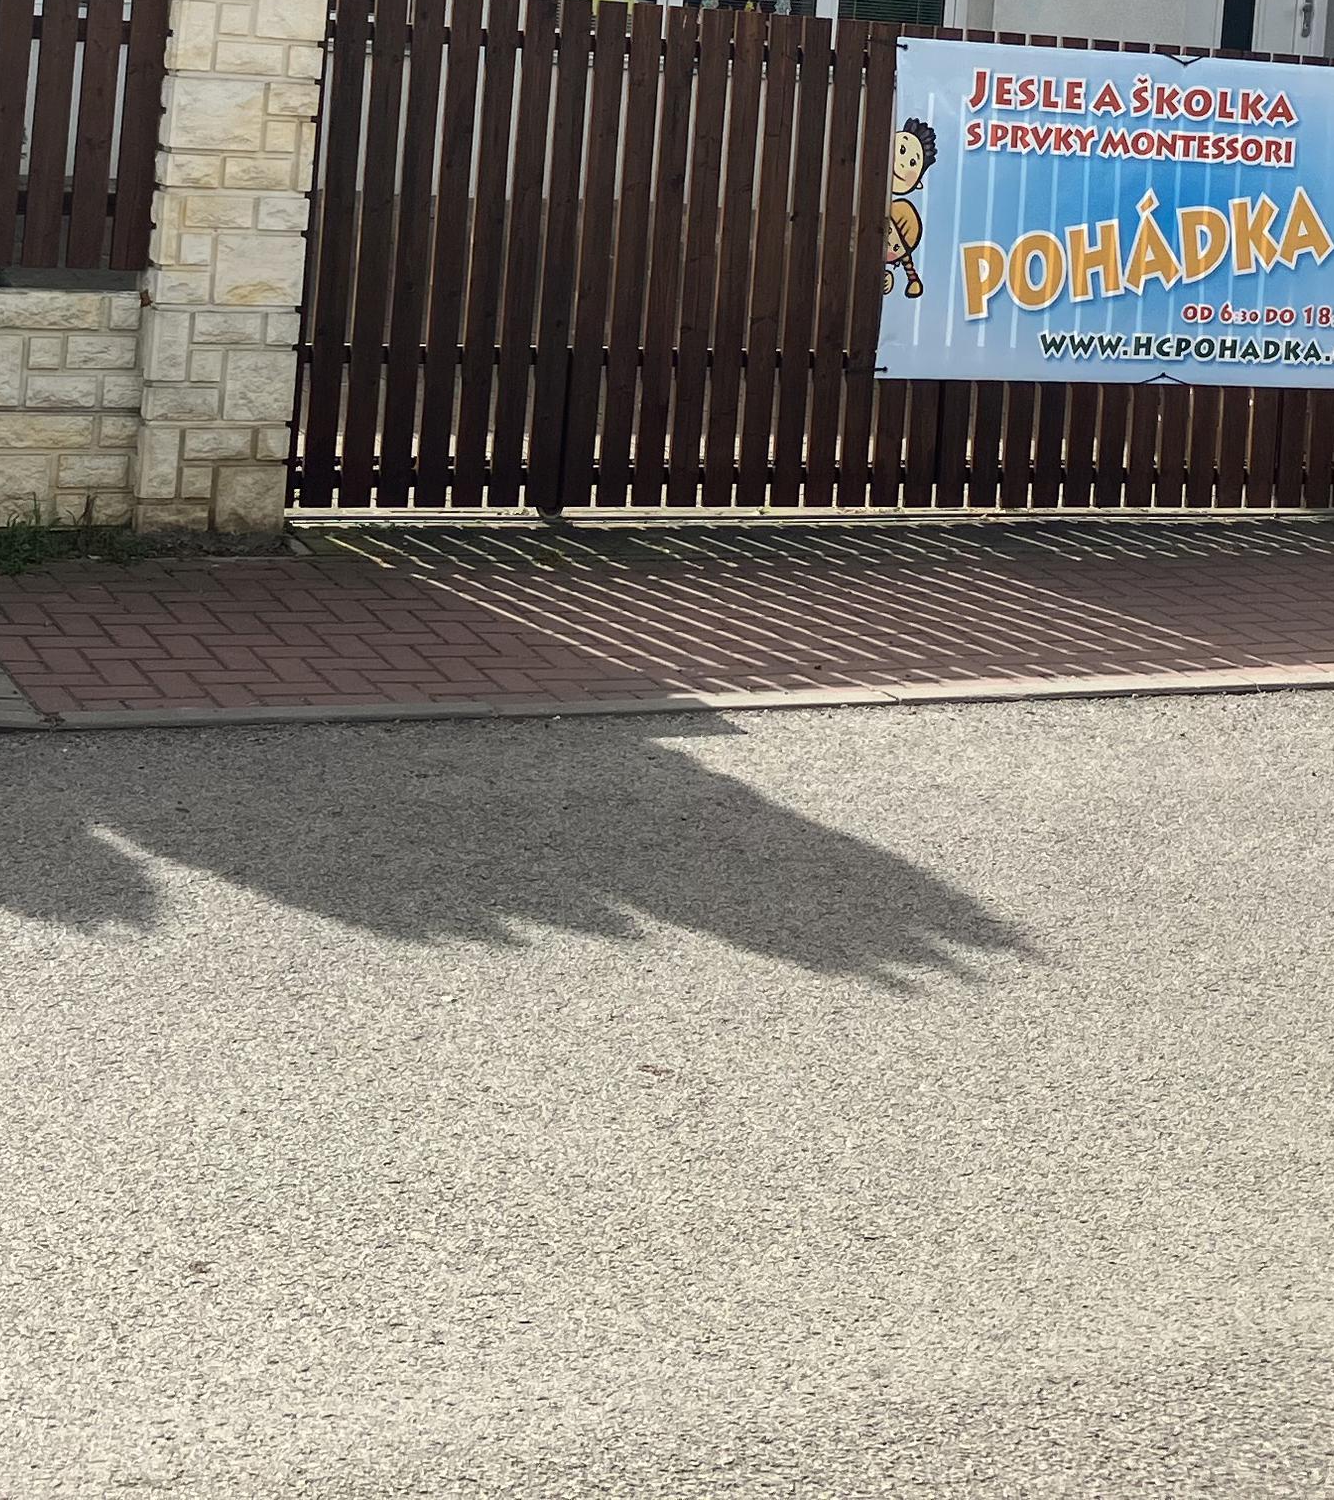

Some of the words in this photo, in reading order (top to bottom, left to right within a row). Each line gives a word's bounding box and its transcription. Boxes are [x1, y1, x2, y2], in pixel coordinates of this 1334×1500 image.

[969, 70, 1085, 113] JESLE
[1092, 82, 1123, 115] A
[1133, 77, 1294, 124] ŠKOLKA
[966, 122, 982, 146] S
[990, 124, 1095, 156] PRVKY
[1101, 128, 1293, 164] MONTESSORI
[963, 190, 1333, 317] POHÁDKA
[1182, 304, 1213, 321] OD
[1219, 303, 1260, 323] 6:30
[1265, 307, 1295, 324] DO
